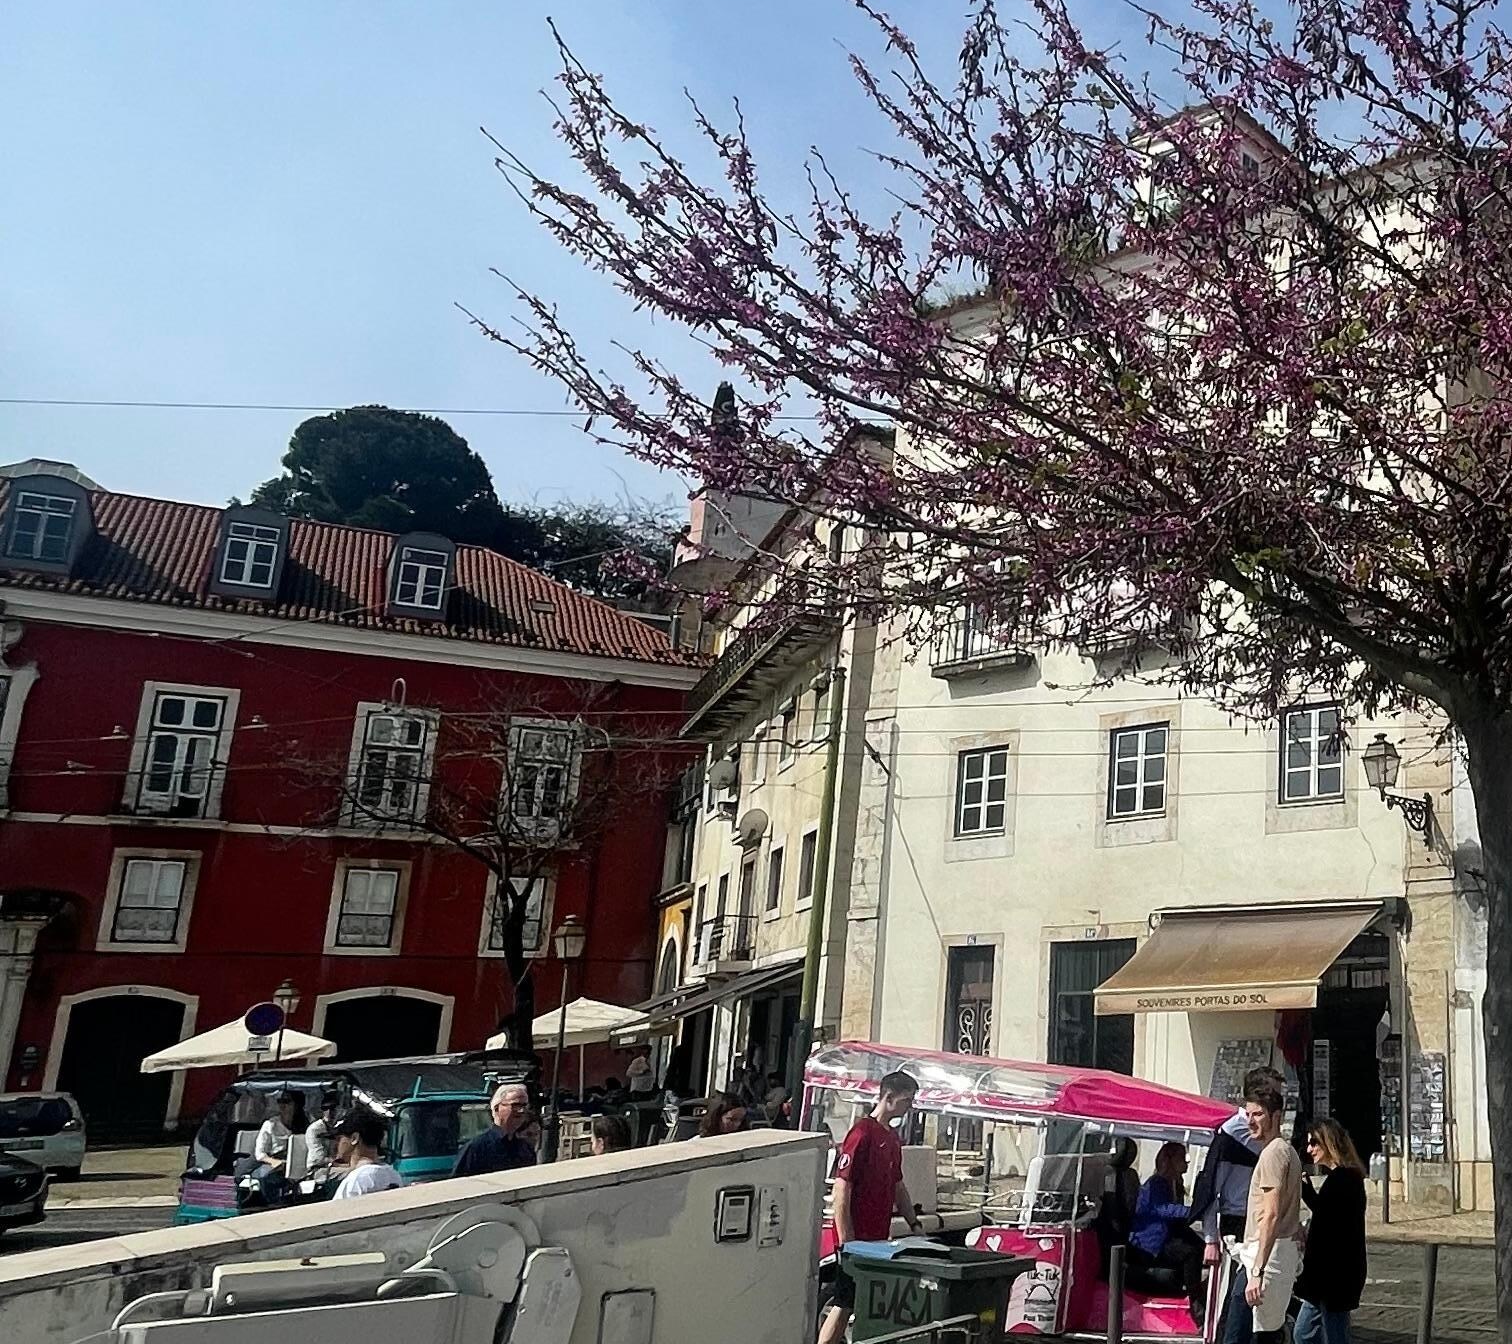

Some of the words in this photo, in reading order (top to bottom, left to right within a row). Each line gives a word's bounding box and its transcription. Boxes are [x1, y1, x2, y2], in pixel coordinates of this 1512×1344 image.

[1194, 996, 1230, 1006] PORTAS
[1233, 994, 1247, 1005] DO
[1249, 993, 1268, 1004] SOL
